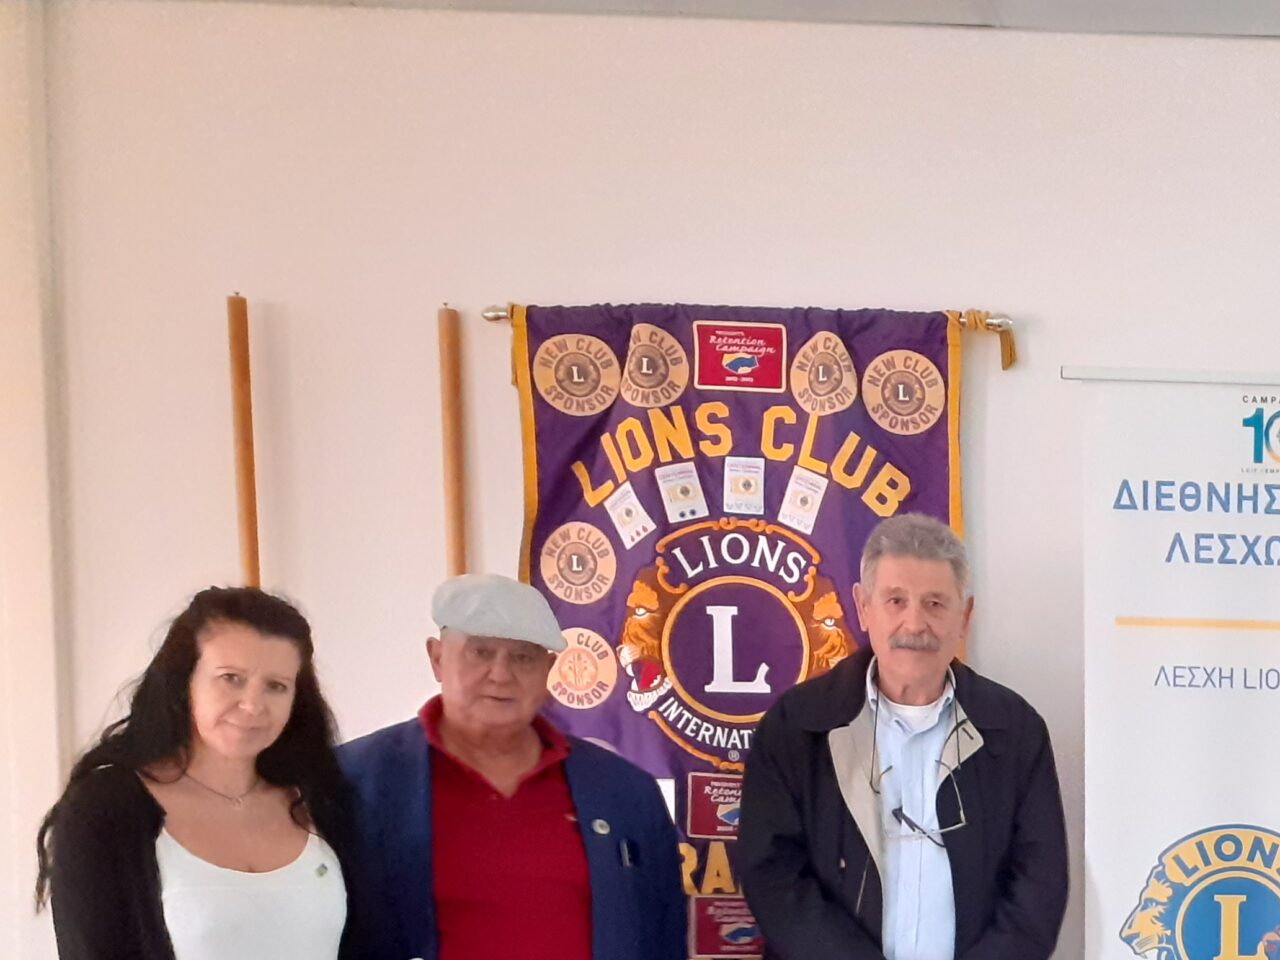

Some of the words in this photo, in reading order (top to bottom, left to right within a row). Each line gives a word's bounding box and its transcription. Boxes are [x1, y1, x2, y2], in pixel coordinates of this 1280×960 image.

[540, 338, 569, 369] NEW
[576, 338, 613, 370] CLUB
[649, 331, 683, 367] CLUB
[709, 335, 766, 346] Retention
[716, 344, 776, 358] Campaign
[796, 341, 818, 372] NEW
[823, 336, 852, 373] CLUB
[571, 366, 584, 383] L
[641, 357, 653, 374] L
[819, 366, 827, 381] L
[867, 356, 897, 387] NEW
[903, 355, 939, 389] CLUB
[544, 384, 614, 412] SPONSOR
[798, 386, 853, 412] SPONSOR
[897, 384, 910, 401] L
[871, 403, 939, 431] SPONSOR
[571, 401, 733, 508] LIONS
[761, 405, 911, 518] CLUB
[546, 528, 571, 558] NEW
[577, 527, 610, 559] CLUB
[571, 555, 583, 572] L
[671, 533, 807, 584] LIONS
[549, 573, 610, 601] SPONSOR
[577, 632, 609, 661] CLUB
[704, 605, 771, 693] L
[1154, 664, 1234, 688] ΛΕΣΧΗ
[552, 680, 609, 707] SPONSOR
[658, 697, 754, 750] INTERNAT
